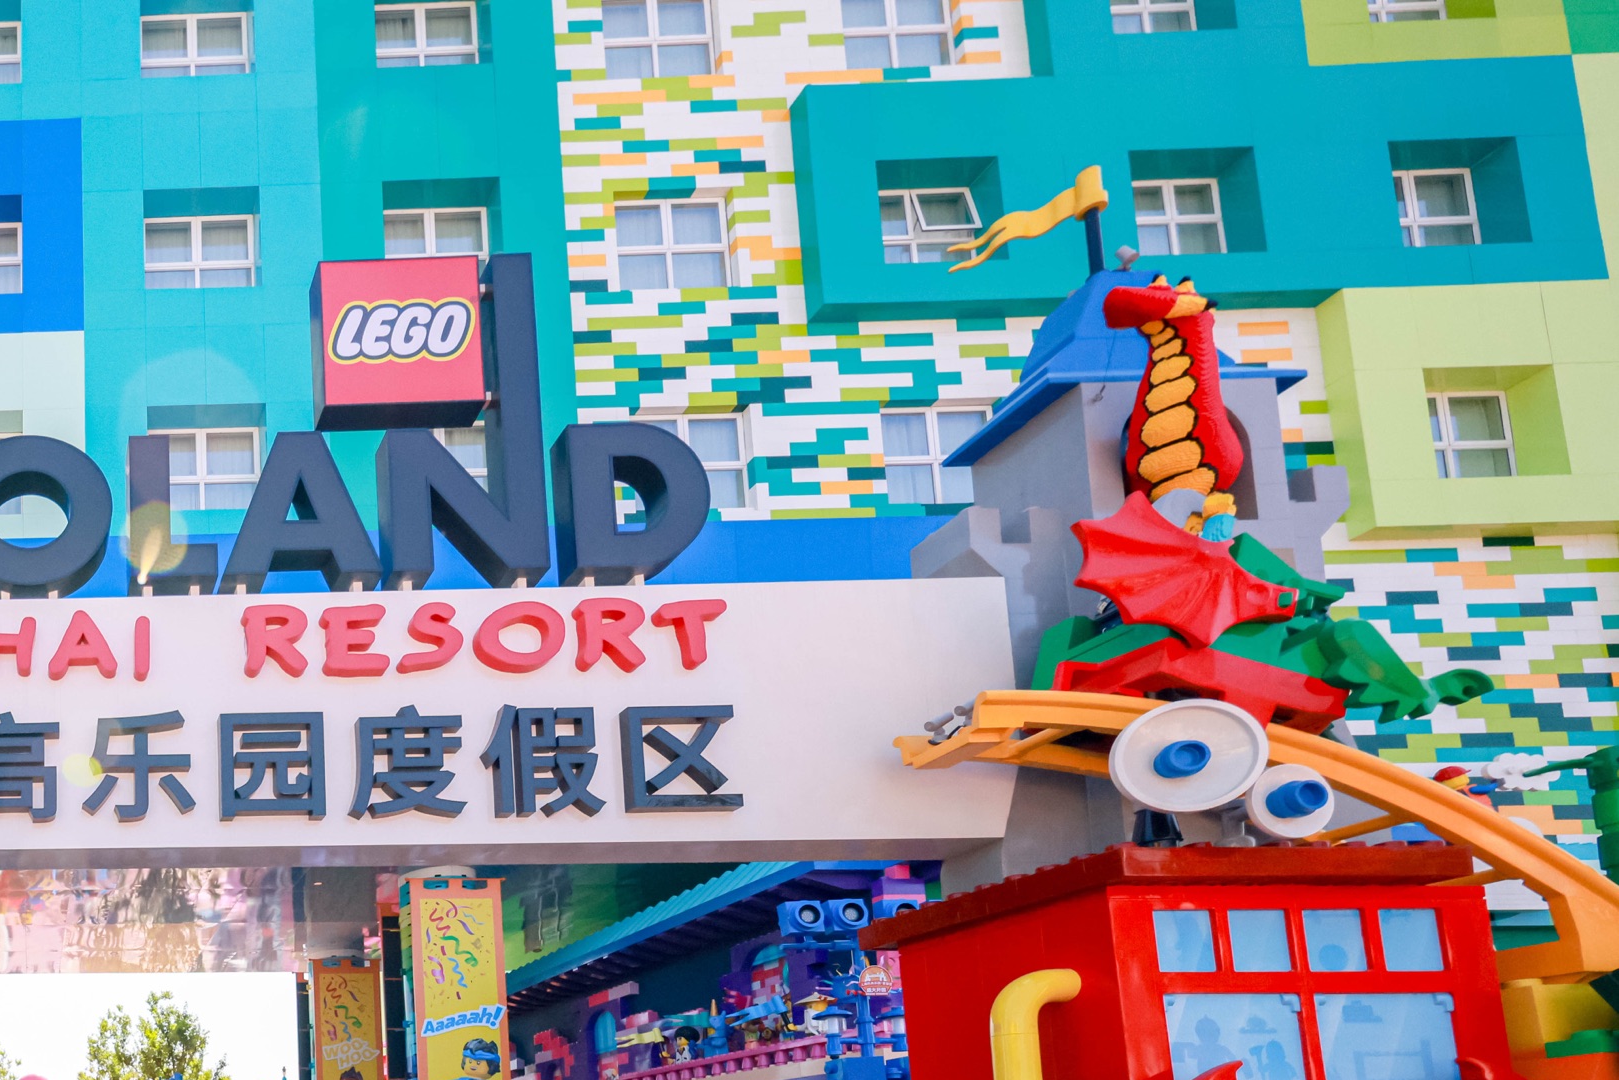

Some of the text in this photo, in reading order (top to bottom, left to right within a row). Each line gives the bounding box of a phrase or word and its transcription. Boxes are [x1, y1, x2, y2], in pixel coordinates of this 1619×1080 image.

[333, 301, 471, 361] LEGO
[240, 597, 728, 679] RESORT
[422, 1005, 504, 1035] Aaaaah!
